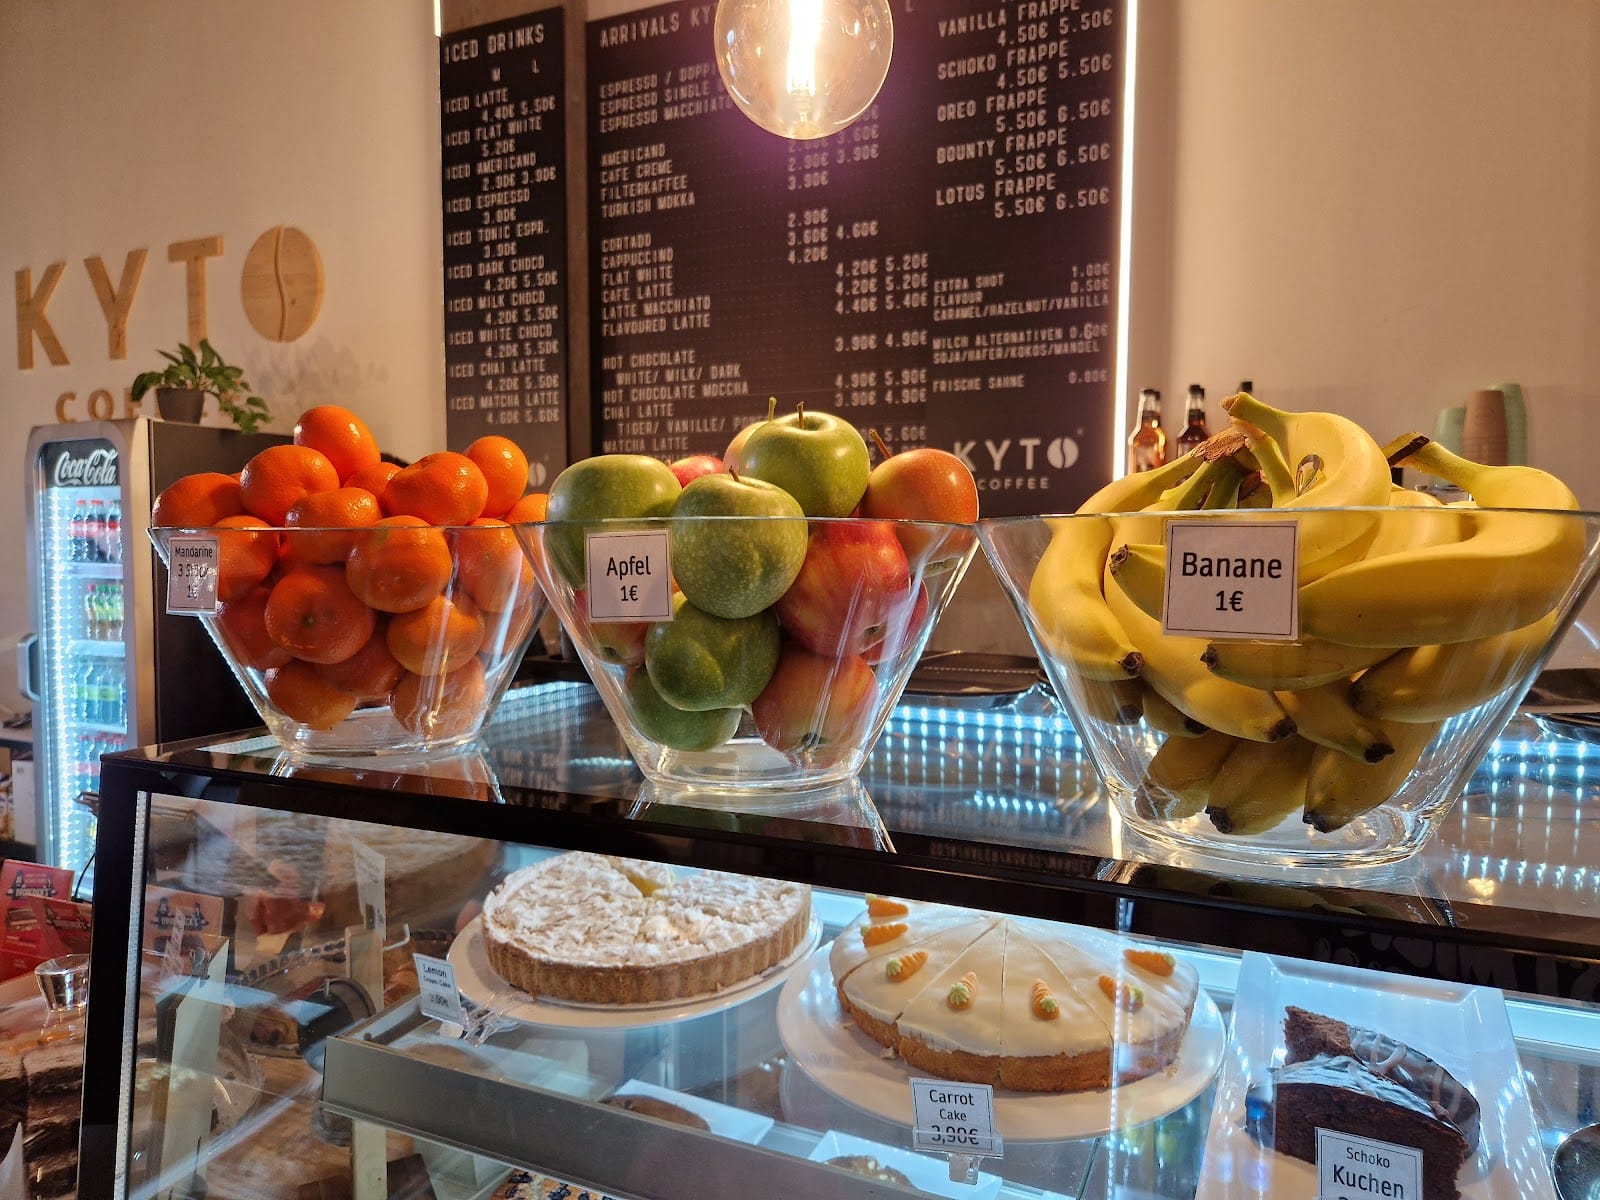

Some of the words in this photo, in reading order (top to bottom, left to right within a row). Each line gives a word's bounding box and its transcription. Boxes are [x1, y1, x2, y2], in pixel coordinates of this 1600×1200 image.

[601, 13, 679, 48] ARRIVALS
[692, 6, 711, 28] KY
[939, 10, 1006, 38] VANILLA
[1019, 0, 1080, 22] FRAPPE
[999, 22, 1048, 46] 4.50€
[1060, 9, 1113, 35] 5.50€
[445, 40, 478, 64] ICED
[488, 25, 544, 54] DRINKS
[533, 60, 539, 73] L
[938, 55, 996, 80] SCHOKO
[1008, 40, 1068, 67] FRAPPE
[601, 75, 657, 99] ESPRESSO
[680, 63, 717, 82] DOPPI
[998, 66, 1048, 90] 4.50€
[1059, 55, 1113, 79] 5.50€
[446, 97, 469, 113] ICED
[476, 88, 508, 107] LATTE
[601, 92, 657, 116] ESPRESSO
[665, 82, 710, 103] SINGLE
[938, 101, 976, 122] OREO
[987, 88, 1047, 113] FRAPPE
[601, 110, 657, 133] ESPRESSO
[997, 110, 1047, 133] 5.50€
[1059, 99, 1111, 123] 6.50€
[446, 131, 470, 147] ICED
[476, 124, 501, 141] FLAT
[509, 116, 541, 135] WHITE
[601, 144, 665, 167] AMERICANO
[937, 140, 995, 164] BOUNTY
[1007, 128, 1067, 153] FRAPPE
[447, 164, 470, 179] ICED
[477, 153, 536, 175] AMERICANO
[996, 153, 1046, 176] 5.50€
[1058, 144, 1111, 167] 6.50€
[601, 168, 629, 184] CAFE
[637, 160, 672, 178] CREME
[602, 175, 687, 202] FILTERKAFFEE
[937, 185, 984, 206] LOTUS
[996, 173, 1056, 198] FRAPPE
[447, 198, 471, 213] ICED
[477, 189, 529, 209] ESPRESSO
[602, 199, 651, 218] TURKISH
[658, 192, 695, 211] MOKKA
[996, 196, 1046, 218] 5.50€
[1057, 188, 1110, 211] 6.50€
[448, 231, 471, 246] ICED
[478, 226, 511, 242] TONIC
[602, 234, 652, 252] CORTADO
[449, 265, 472, 280] ICED
[479, 261, 504, 276] DARK
[511, 256, 545, 272] CHOCO
[602, 247, 673, 270] CAPPUCCINO
[836, 259, 878, 278] 4.20€
[886, 254, 928, 272] 5.20€
[603, 271, 629, 286] FLAT
[637, 266, 672, 283] WHITE
[836, 279, 877, 296] 4.20€
[886, 273, 928, 291] 5.20€
[934, 278, 969, 293] EXTRA
[976, 273, 1004, 289] SHOT
[450, 298, 473, 312] ICED
[479, 295, 505, 310] MILK
[512, 292, 545, 306] CHOCO
[603, 288, 630, 304] CAFE
[638, 283, 672, 300] LATTE
[836, 298, 877, 315] 4.40€
[886, 293, 928, 310] 5.40€
[603, 304, 637, 320] LATTE
[644, 296, 710, 316] MACCHIATO
[451, 331, 473, 345] ICED
[481, 328, 512, 342] WHITE
[519, 324, 552, 339] CHOCO
[603, 318, 666, 337] FLAVOURED
[674, 314, 710, 330] LATTE
[934, 336, 969, 350] MILCH
[976, 328, 1063, 347] ALTERNATIVEN
[452, 364, 474, 378] ICED
[482, 362, 505, 376] CHAI
[513, 359, 545, 374] LATTE
[604, 356, 623, 370] HOT
[632, 351, 695, 368] CHOCOLATE
[617, 371, 659, 386] WHITE/
[666, 368, 703, 383] MILK/
[711, 364, 741, 380] DARK
[934, 377, 982, 393] FRISCHE
[989, 375, 1025, 389] SAHNE
[452, 396, 475, 410] ICED
[481, 394, 519, 408] MATCHA
[527, 392, 559, 406] LATTE
[604, 389, 623, 403] HOT
[632, 385, 696, 402] CHOCOLATE
[703, 382, 749, 397] MOCCHA
[605, 406, 630, 420] CHAI
[639, 404, 674, 418] LATTE
[619, 422, 659, 436] TIGER/
[668, 419, 725, 433] VANILLE/
[604, 439, 645, 453] MATCHA
[655, 437, 689, 451] LATTE
[977, 477, 1049, 490] COFFEE
[175, 546, 213, 558] Mandarine
[606, 555, 652, 580] Apfel
[1182, 552, 1282, 579] Banane
[620, 585, 638, 601] 1€
[1216, 590, 1244, 612] 1€
[423, 963, 448, 978] Lemon
[929, 1089, 975, 1106] Carrot
[939, 1108, 967, 1122] Cake
[931, 1125, 979, 1145] 3,90€
[1346, 1147, 1390, 1169] Schoko
[1333, 1163, 1404, 1199] Kuchen
